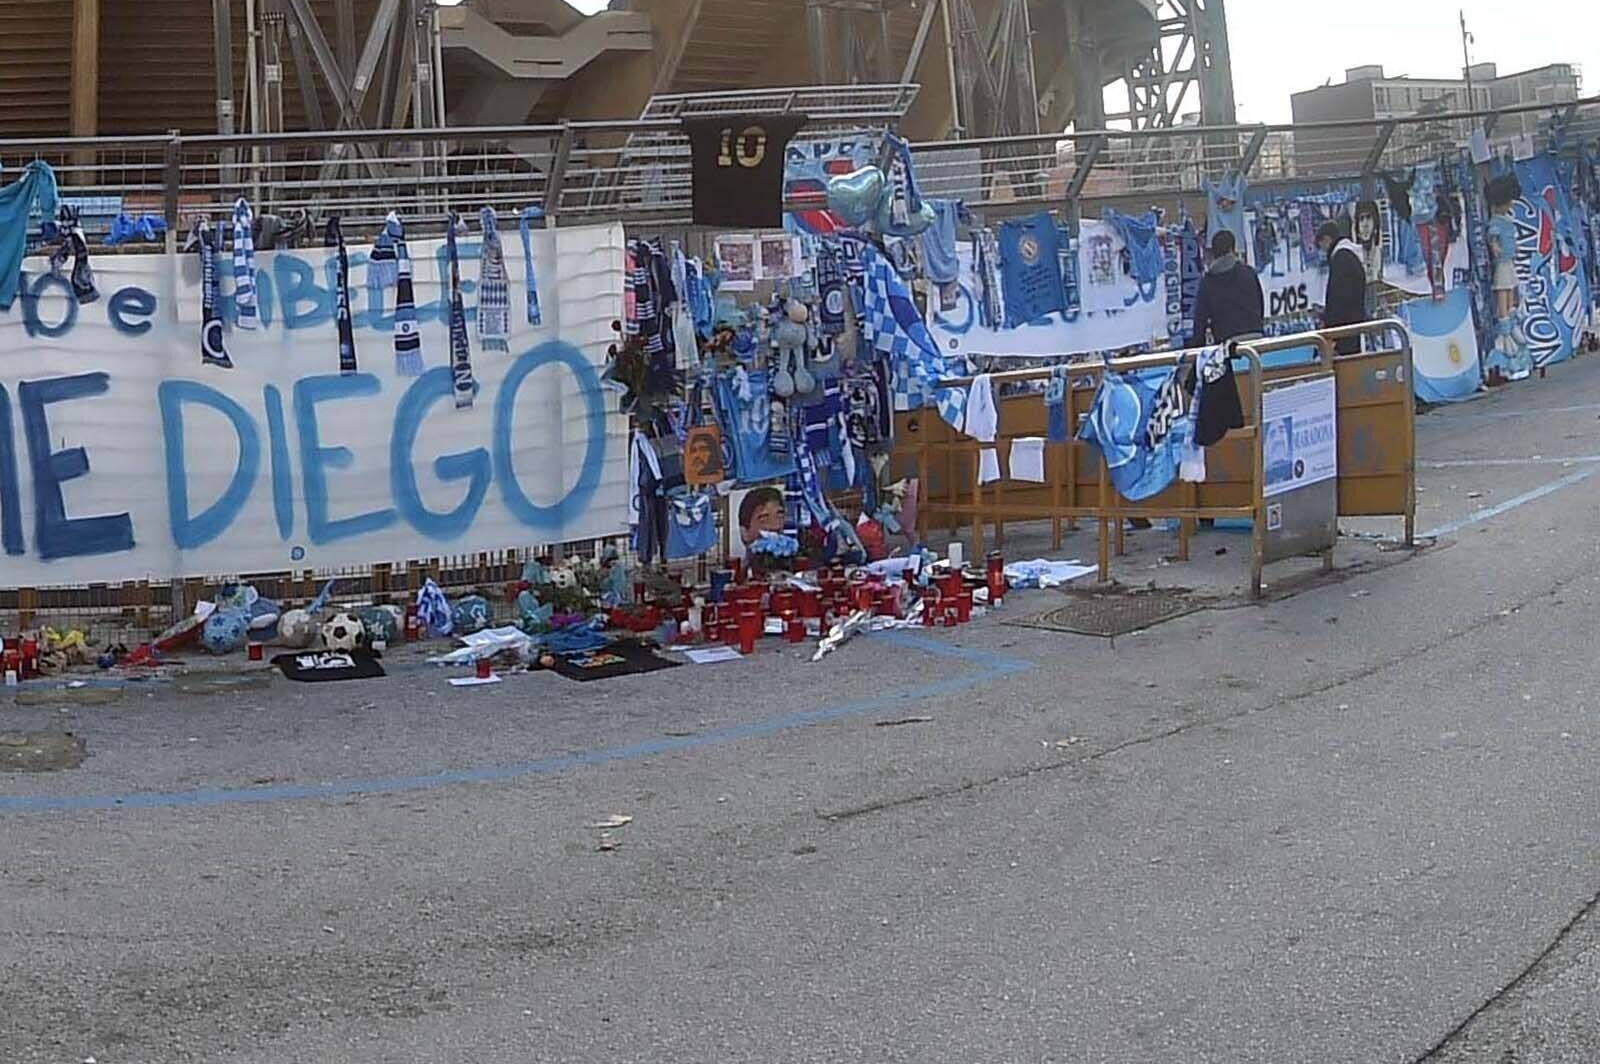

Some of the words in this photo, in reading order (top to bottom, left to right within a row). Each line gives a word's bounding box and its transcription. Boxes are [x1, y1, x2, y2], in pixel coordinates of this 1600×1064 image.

[717, 126, 767, 167] 10
[107, 286, 157, 338] e
[158, 340, 608, 550] DIEGO
